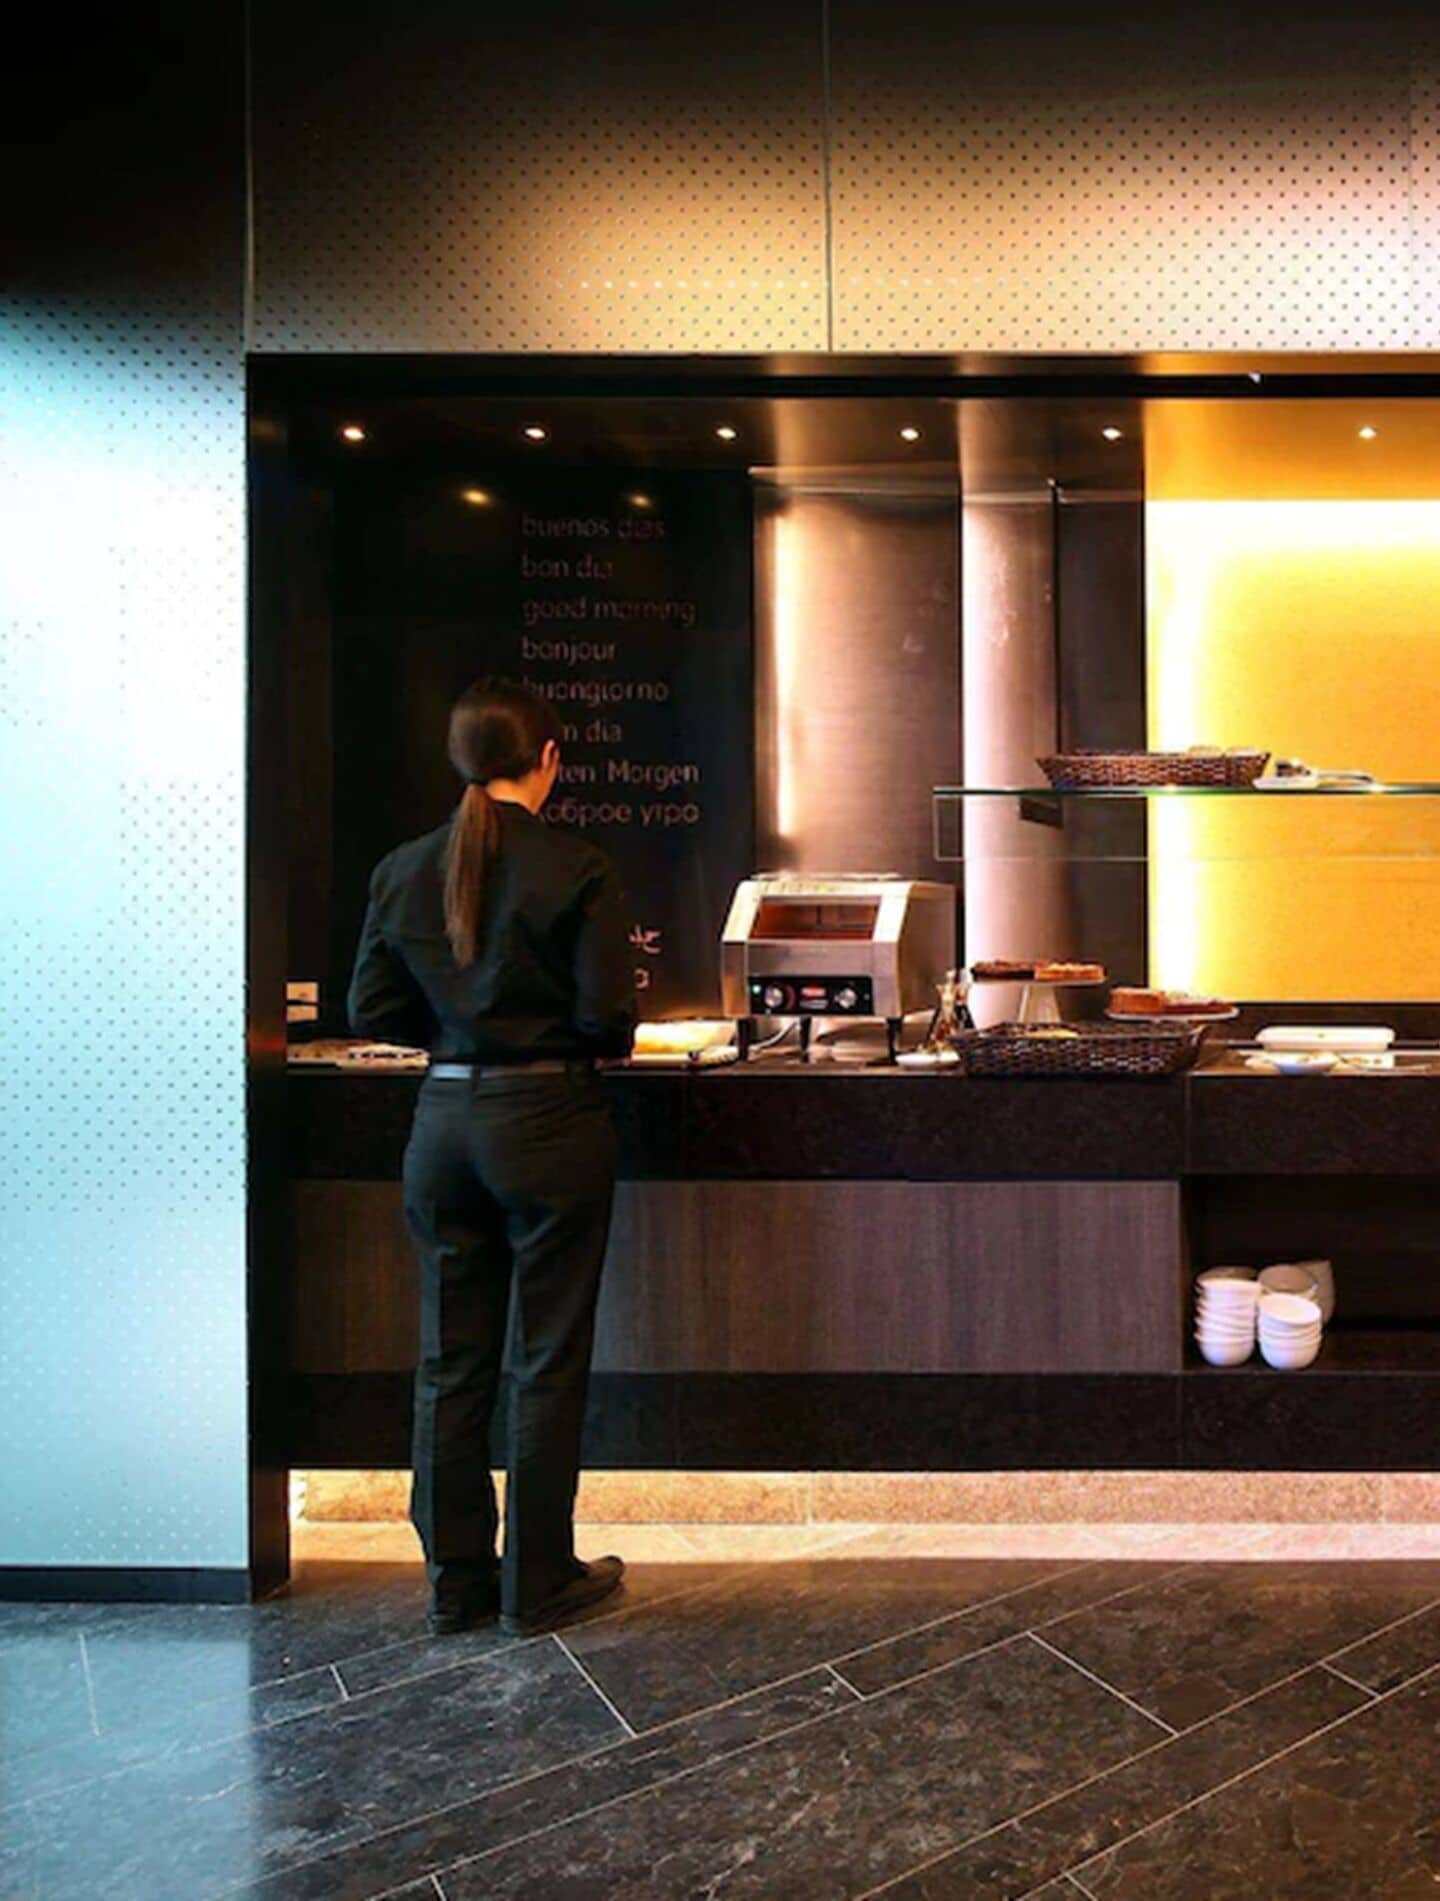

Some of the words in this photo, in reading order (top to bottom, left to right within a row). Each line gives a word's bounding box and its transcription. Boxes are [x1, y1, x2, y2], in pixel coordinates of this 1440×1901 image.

[521, 512, 609, 537] buenos
[521, 549, 569, 577] bon
[522, 596, 587, 625] good
[593, 597, 697, 627] morning
[521, 635, 618, 666] bonjour
[558, 761, 596, 783] ten
[607, 759, 700, 791] Morgen
[539, 797, 632, 828] оброе
